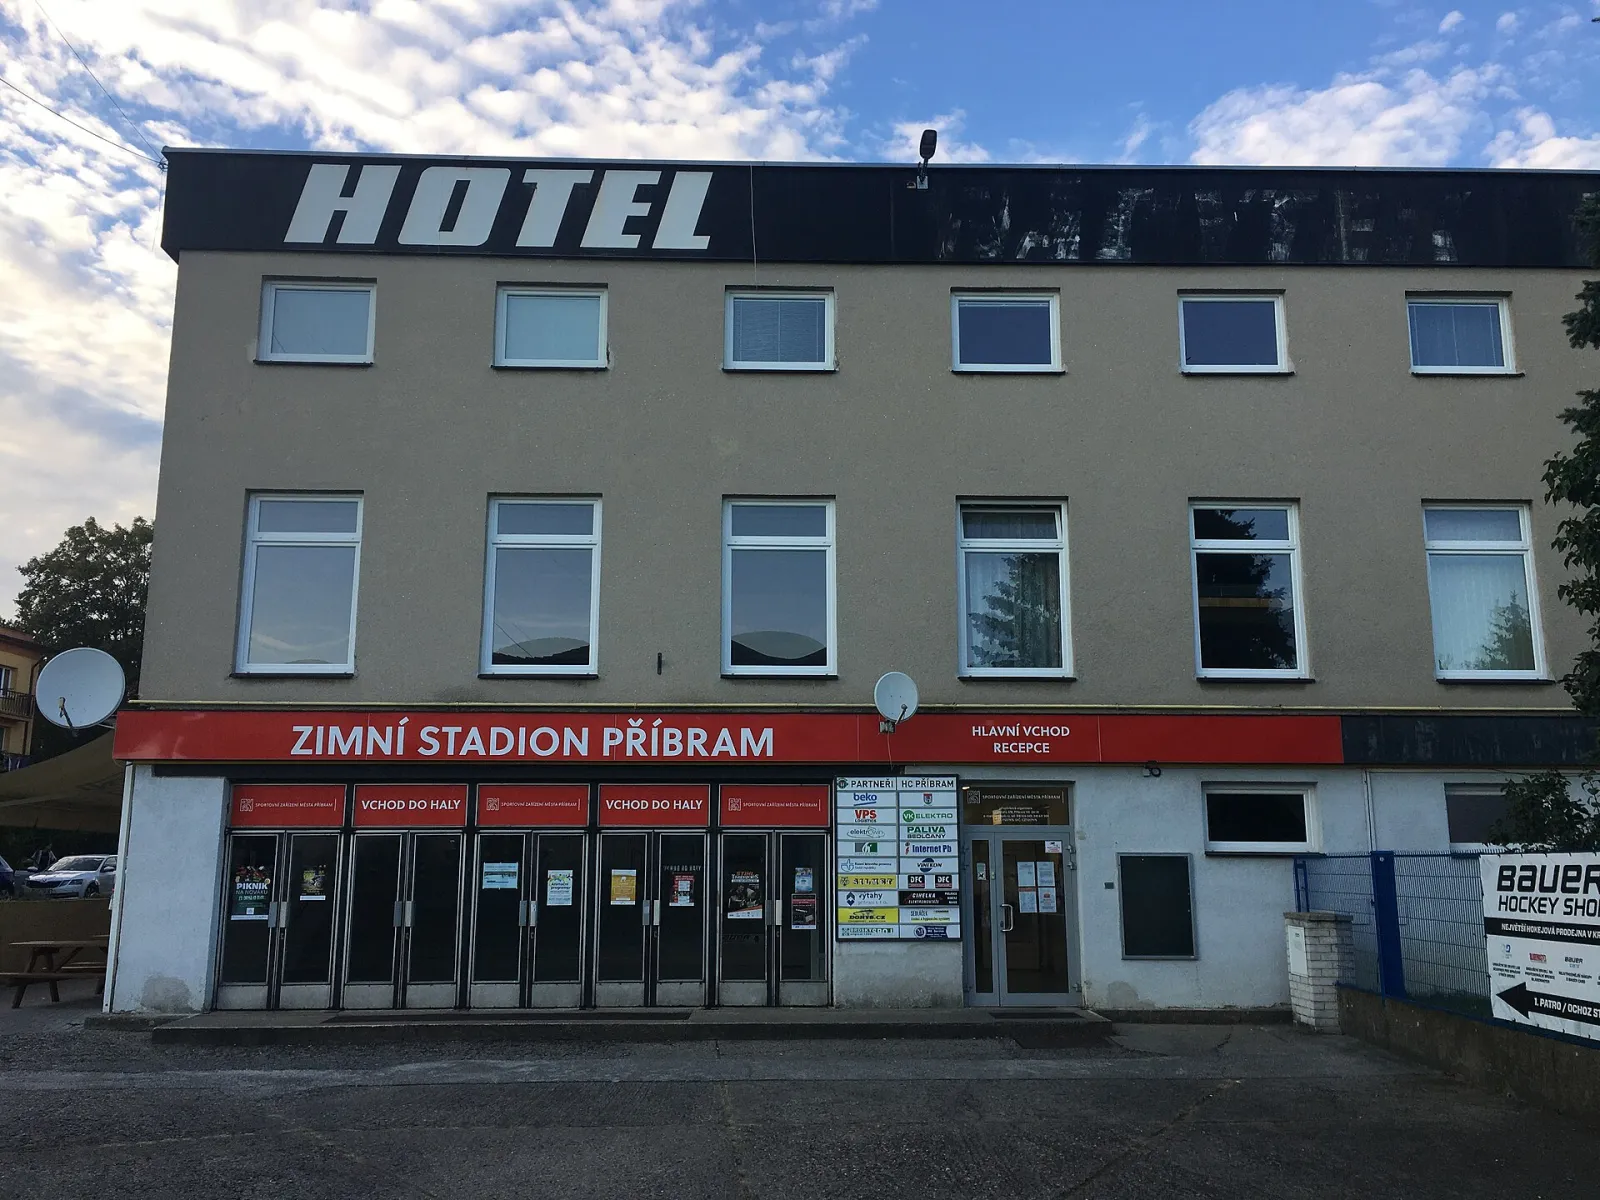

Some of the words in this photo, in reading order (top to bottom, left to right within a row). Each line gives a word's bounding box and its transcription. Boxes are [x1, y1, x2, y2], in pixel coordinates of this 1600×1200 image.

[283, 163, 713, 249] HOTEL
[972, 723, 1020, 737] HLAVNÍ
[1023, 726, 1070, 737] VCHOD
[290, 716, 410, 755] ZIMNÍ
[417, 726, 589, 756] STADION
[602, 717, 774, 756] PŘÍBRAM
[993, 742, 1050, 753] RECEPCE
[851, 778, 894, 788] PARTNEŘI
[901, 780, 913, 788] HC
[915, 778, 954, 788] PŘÍBRAM
[853, 792, 877, 801] beko
[361, 800, 405, 810] VCHOD
[408, 800, 427, 810] DO
[430, 800, 461, 810] HALY
[606, 800, 649, 810] VCHOD
[652, 800, 670, 810] DO
[673, 800, 703, 810] HALY
[855, 809, 877, 819] VPS
[912, 844, 942, 853] Internet
[943, 844, 952, 853] Pb
[236, 882, 268, 890] PIKNIK
[1498, 895, 1560, 914] HOCKEY
[1563, 898, 1600, 917] SHO
[1501, 922, 1526, 932] NEJVĚTŠÍ
[1526, 925, 1556, 935] HOKEJOVÁ
[1556, 927, 1587, 938] PRODEJNA
[1587, 930, 1592, 938] V
[1534, 997, 1540, 1006] 1.
[1540, 998, 1561, 1010] PATRO
[1562, 1003, 1566, 1013] /
[1567, 1004, 1592, 1016] OCHOZ
